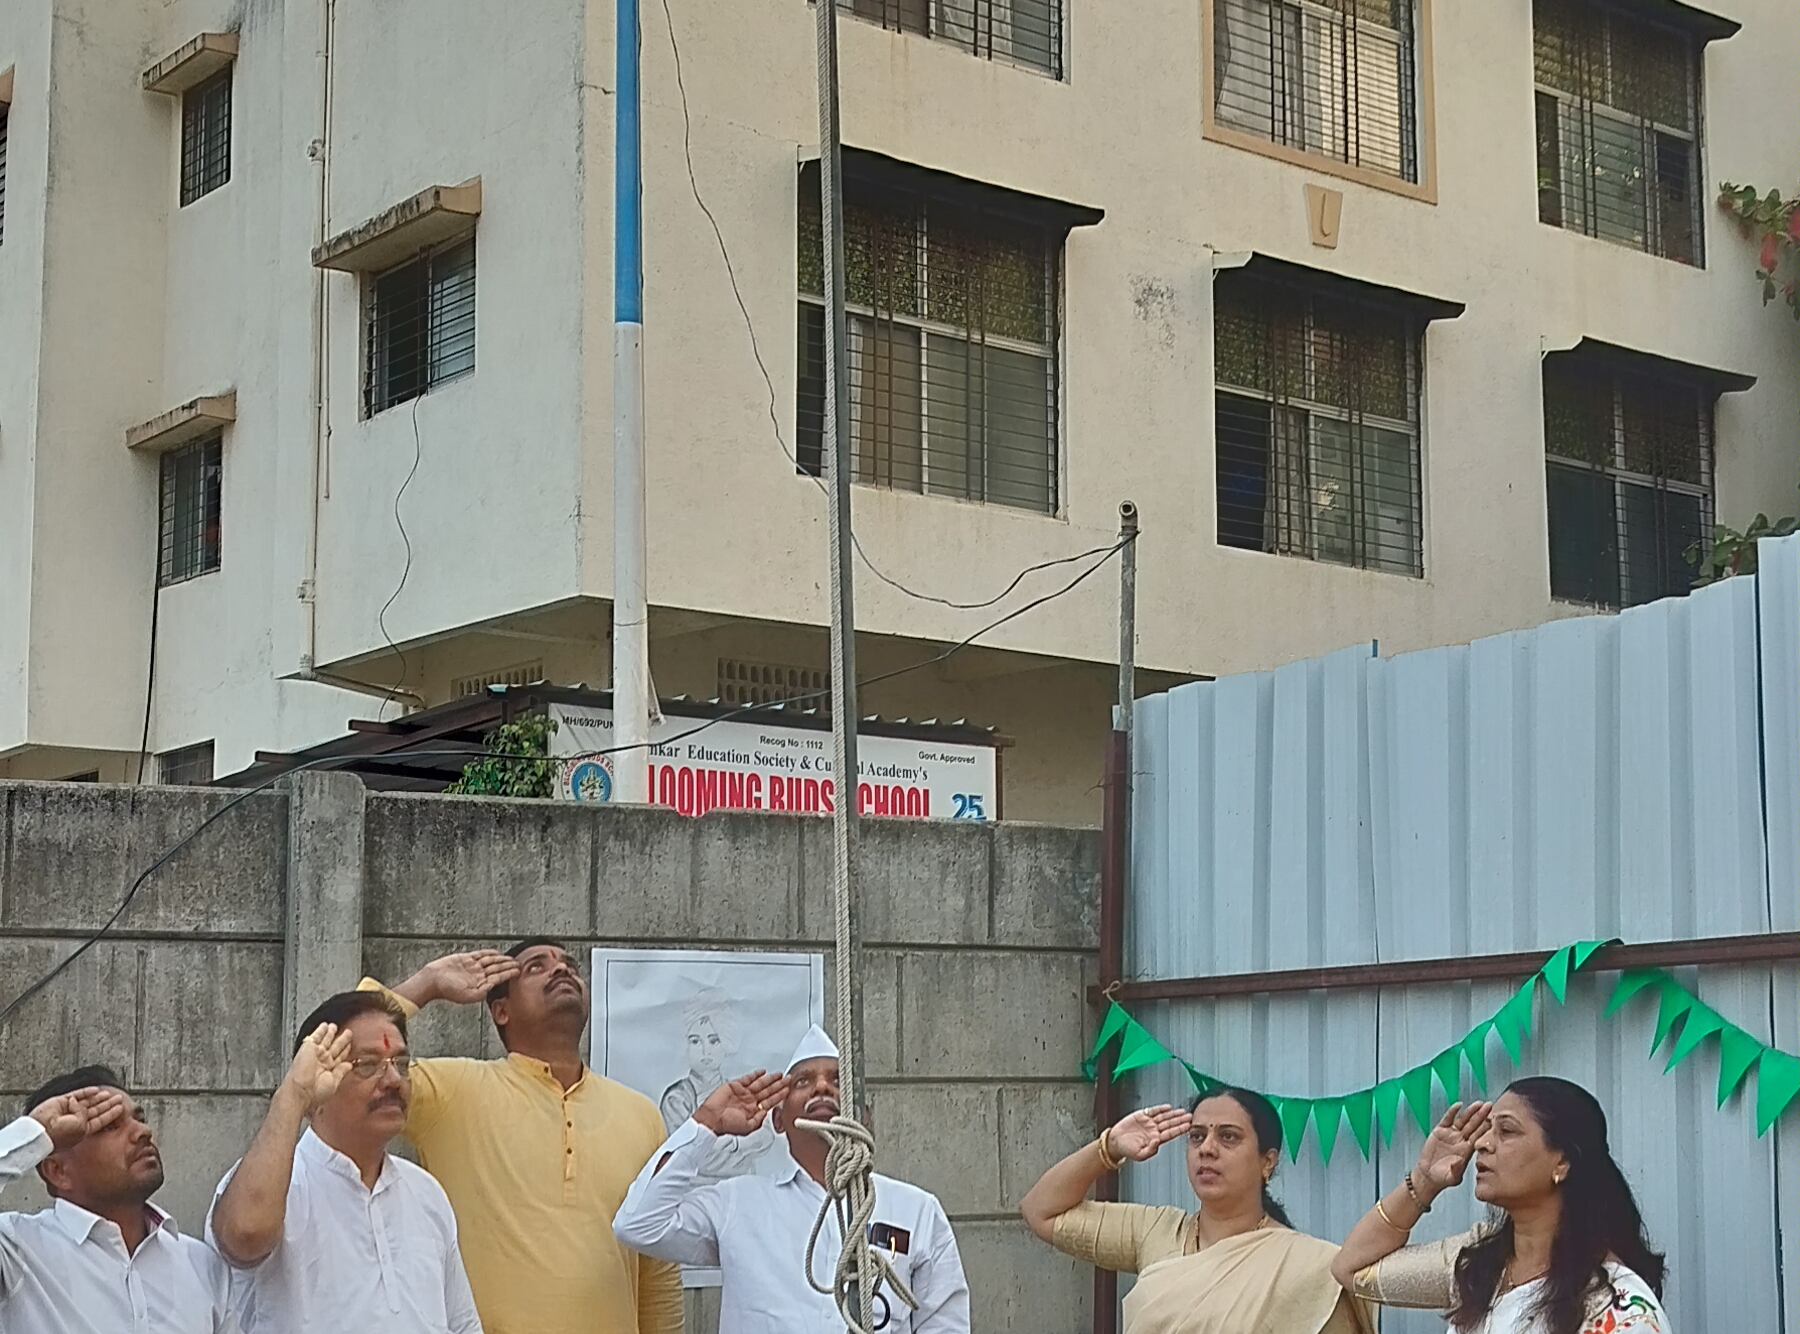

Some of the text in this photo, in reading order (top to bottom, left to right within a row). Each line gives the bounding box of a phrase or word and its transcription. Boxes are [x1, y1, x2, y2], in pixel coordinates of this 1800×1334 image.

[760, 735, 786, 748] Recog
[788, 738, 799, 747] No
[806, 740, 823, 749] 1112
[688, 745, 750, 764] Education
[754, 752, 797, 772] Society
[800, 756, 811, 770] &
[867, 762, 928, 783] Academy's
[918, 750, 975, 764] Govt. Approved
[952, 793, 987, 820] 25
